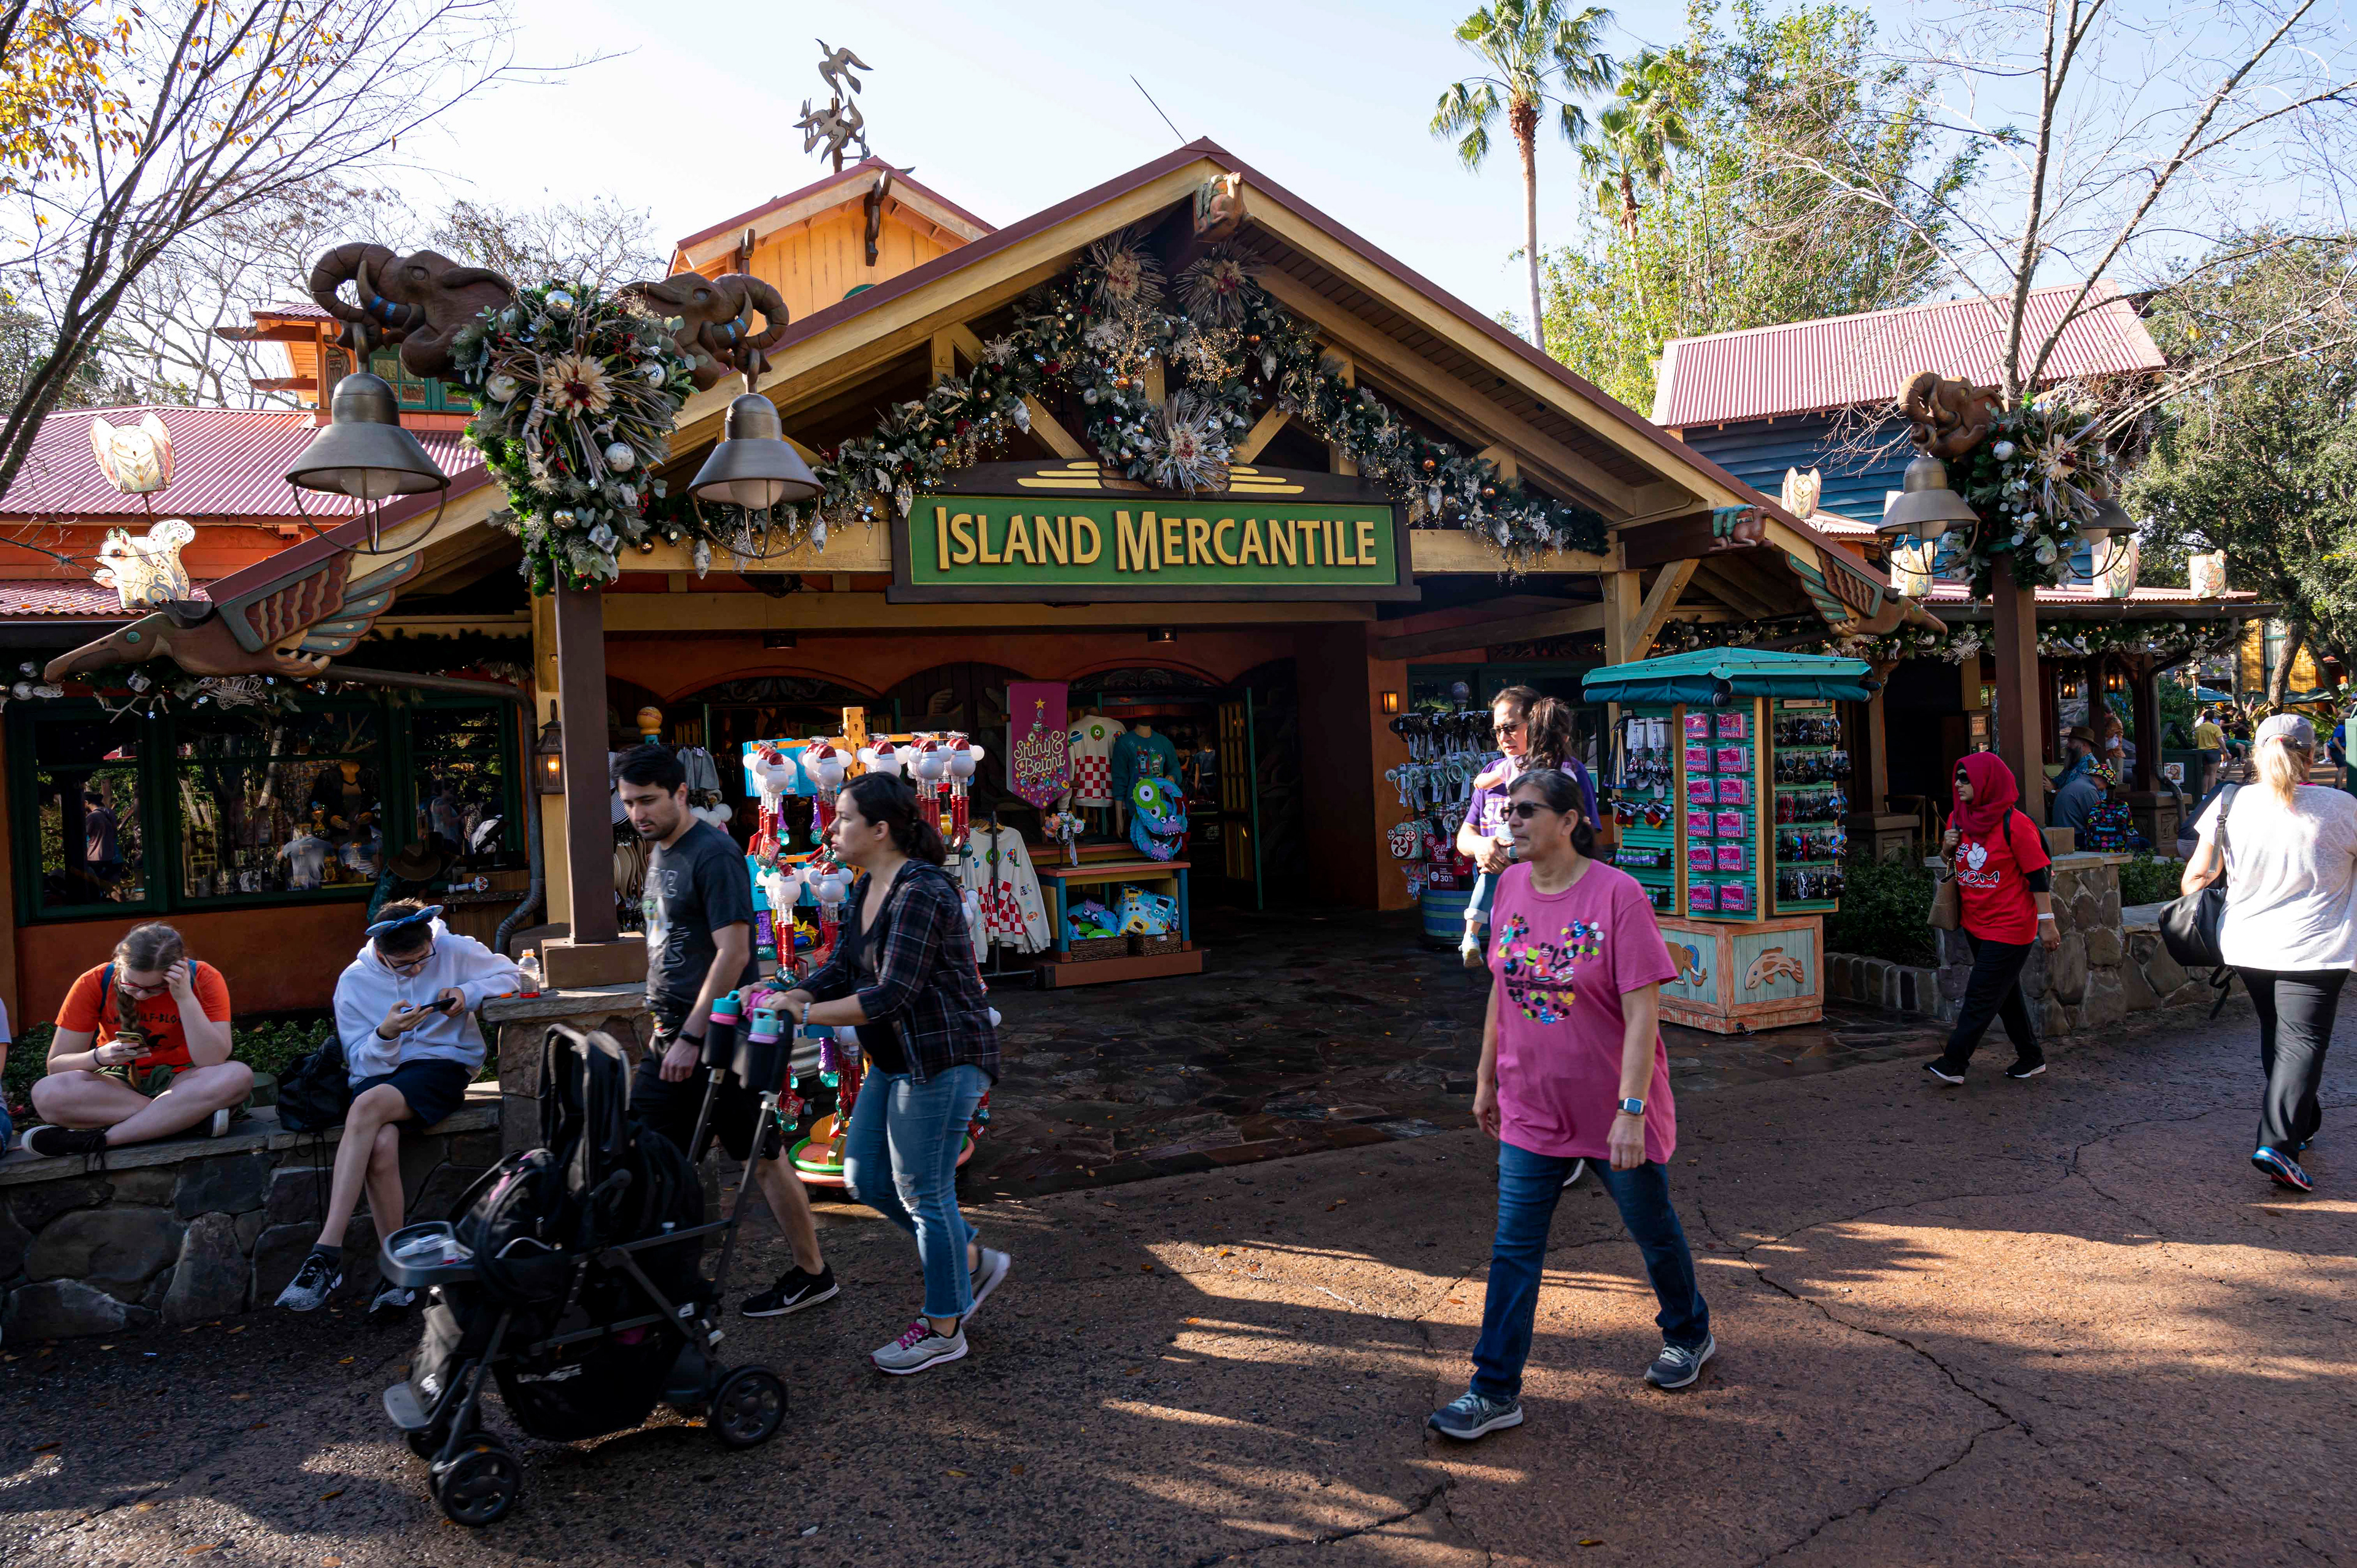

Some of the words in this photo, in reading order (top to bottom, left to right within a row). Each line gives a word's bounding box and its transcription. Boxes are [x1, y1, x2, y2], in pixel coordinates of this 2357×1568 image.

[935, 506, 1102, 571] ISLAND
[1113, 510, 1377, 573] MERCANTILE
[1014, 740, 1051, 759] Shiny
[1051, 730, 1066, 754] &
[1015, 753, 1066, 778] Bright
[1957, 869, 2000, 883] MOM
